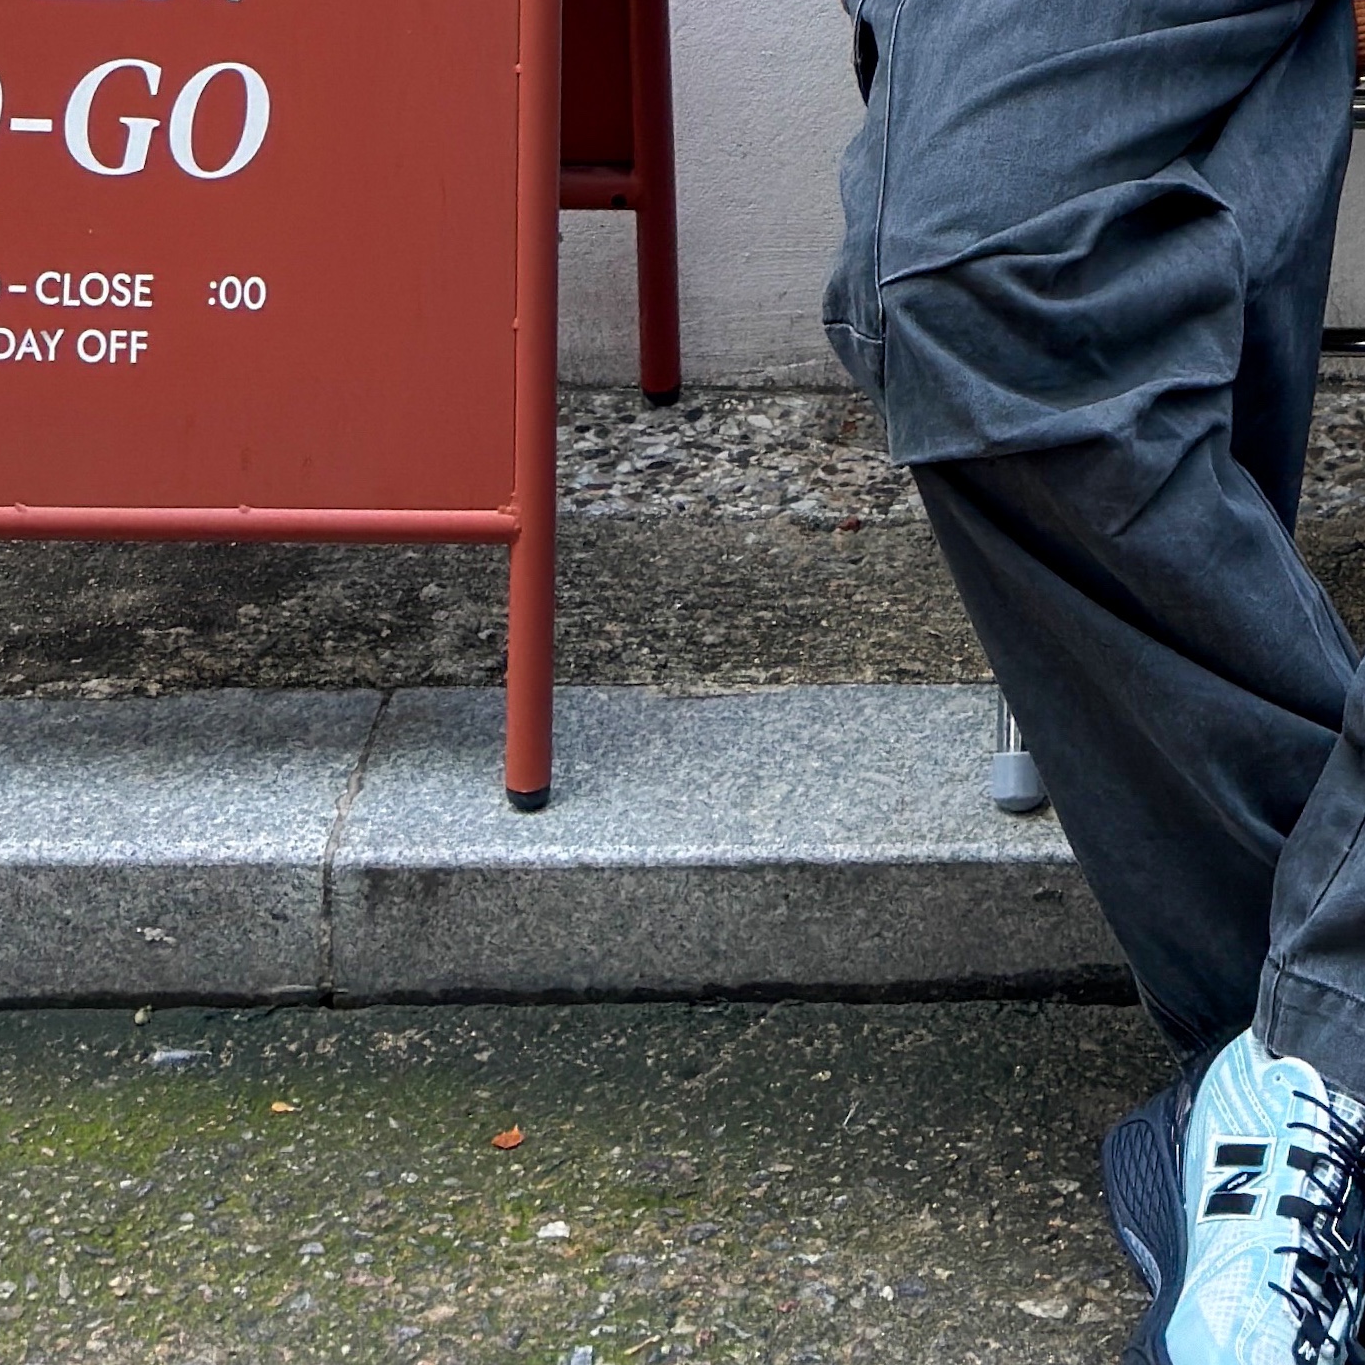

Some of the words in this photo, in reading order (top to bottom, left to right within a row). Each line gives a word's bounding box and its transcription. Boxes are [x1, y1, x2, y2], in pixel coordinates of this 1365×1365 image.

[35, 271, 154, 309] CLOSE
[208, 275, 267, 311] :00
[76, 329, 148, 365] OFF
